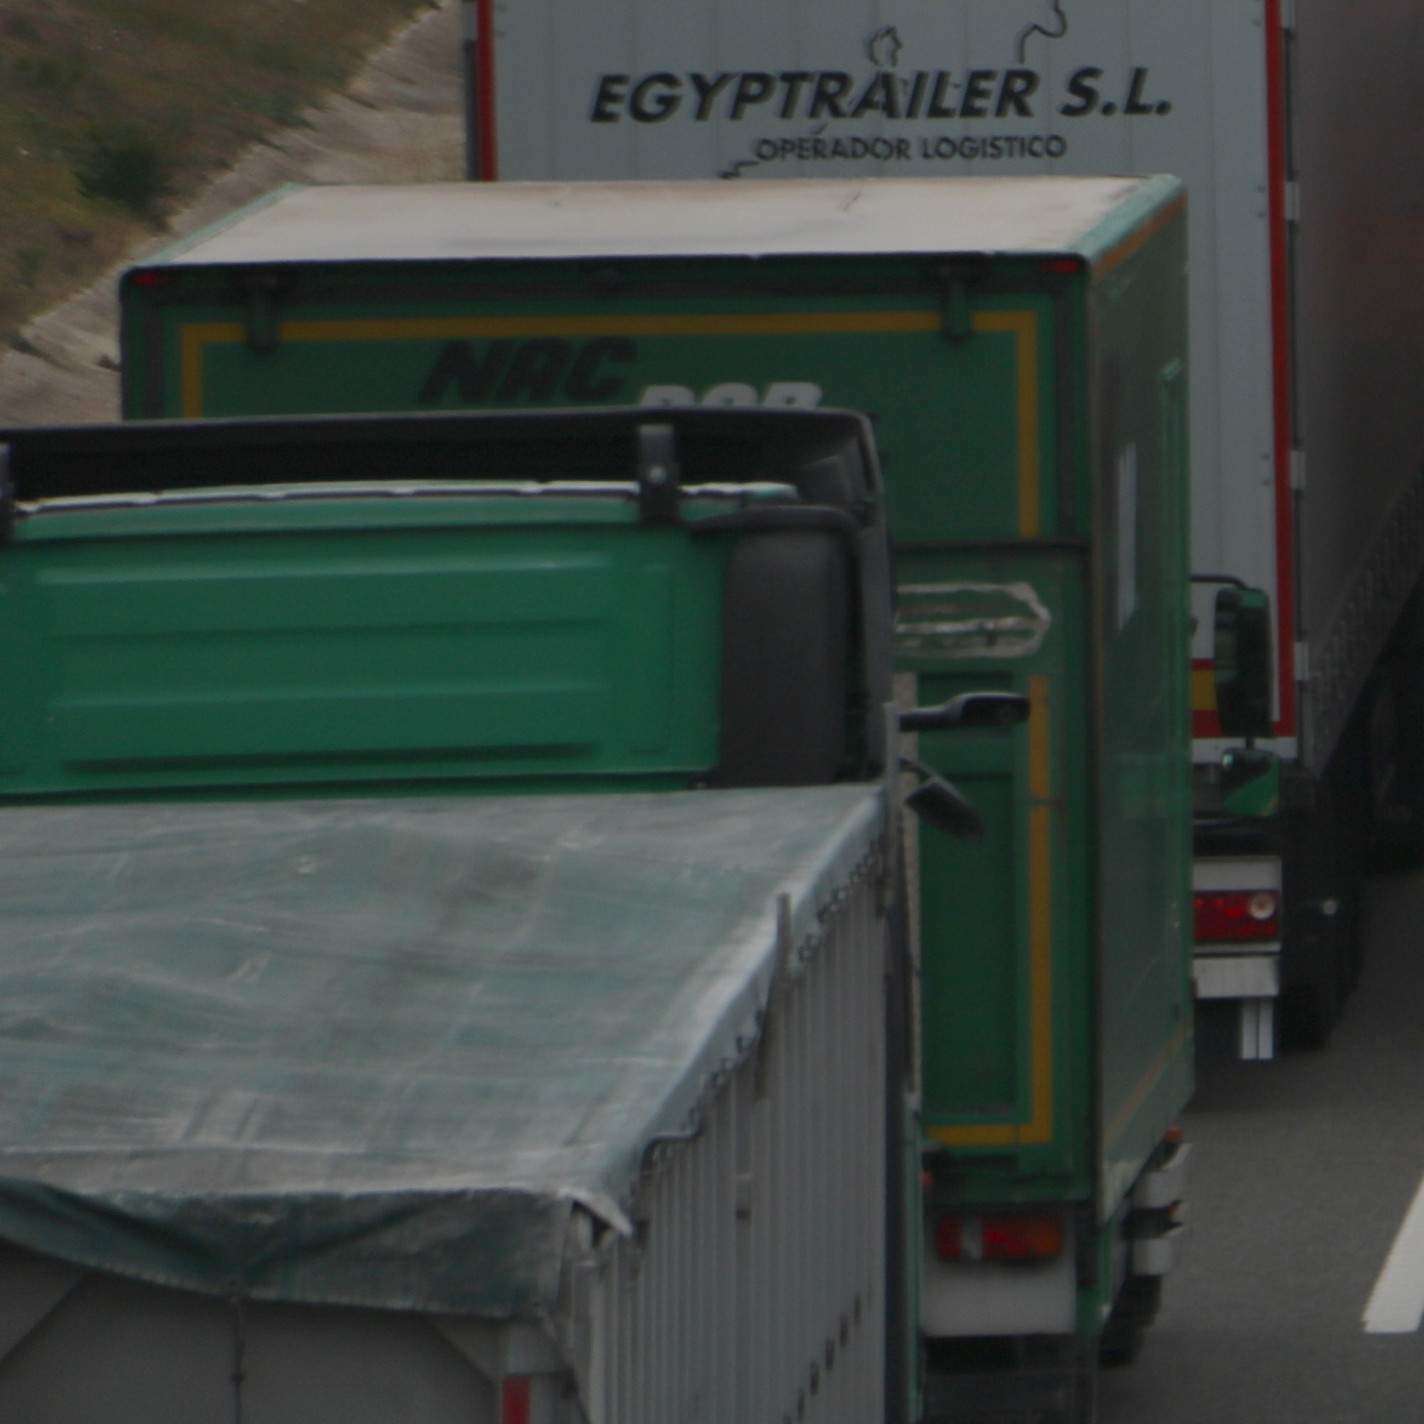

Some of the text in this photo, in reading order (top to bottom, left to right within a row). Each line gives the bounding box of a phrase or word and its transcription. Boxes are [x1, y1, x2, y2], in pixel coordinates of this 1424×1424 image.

[590, 67, 1174, 123] EGYPTRAILER S.L.
[757, 134, 1066, 161] OPERADOR LOGISTICO
